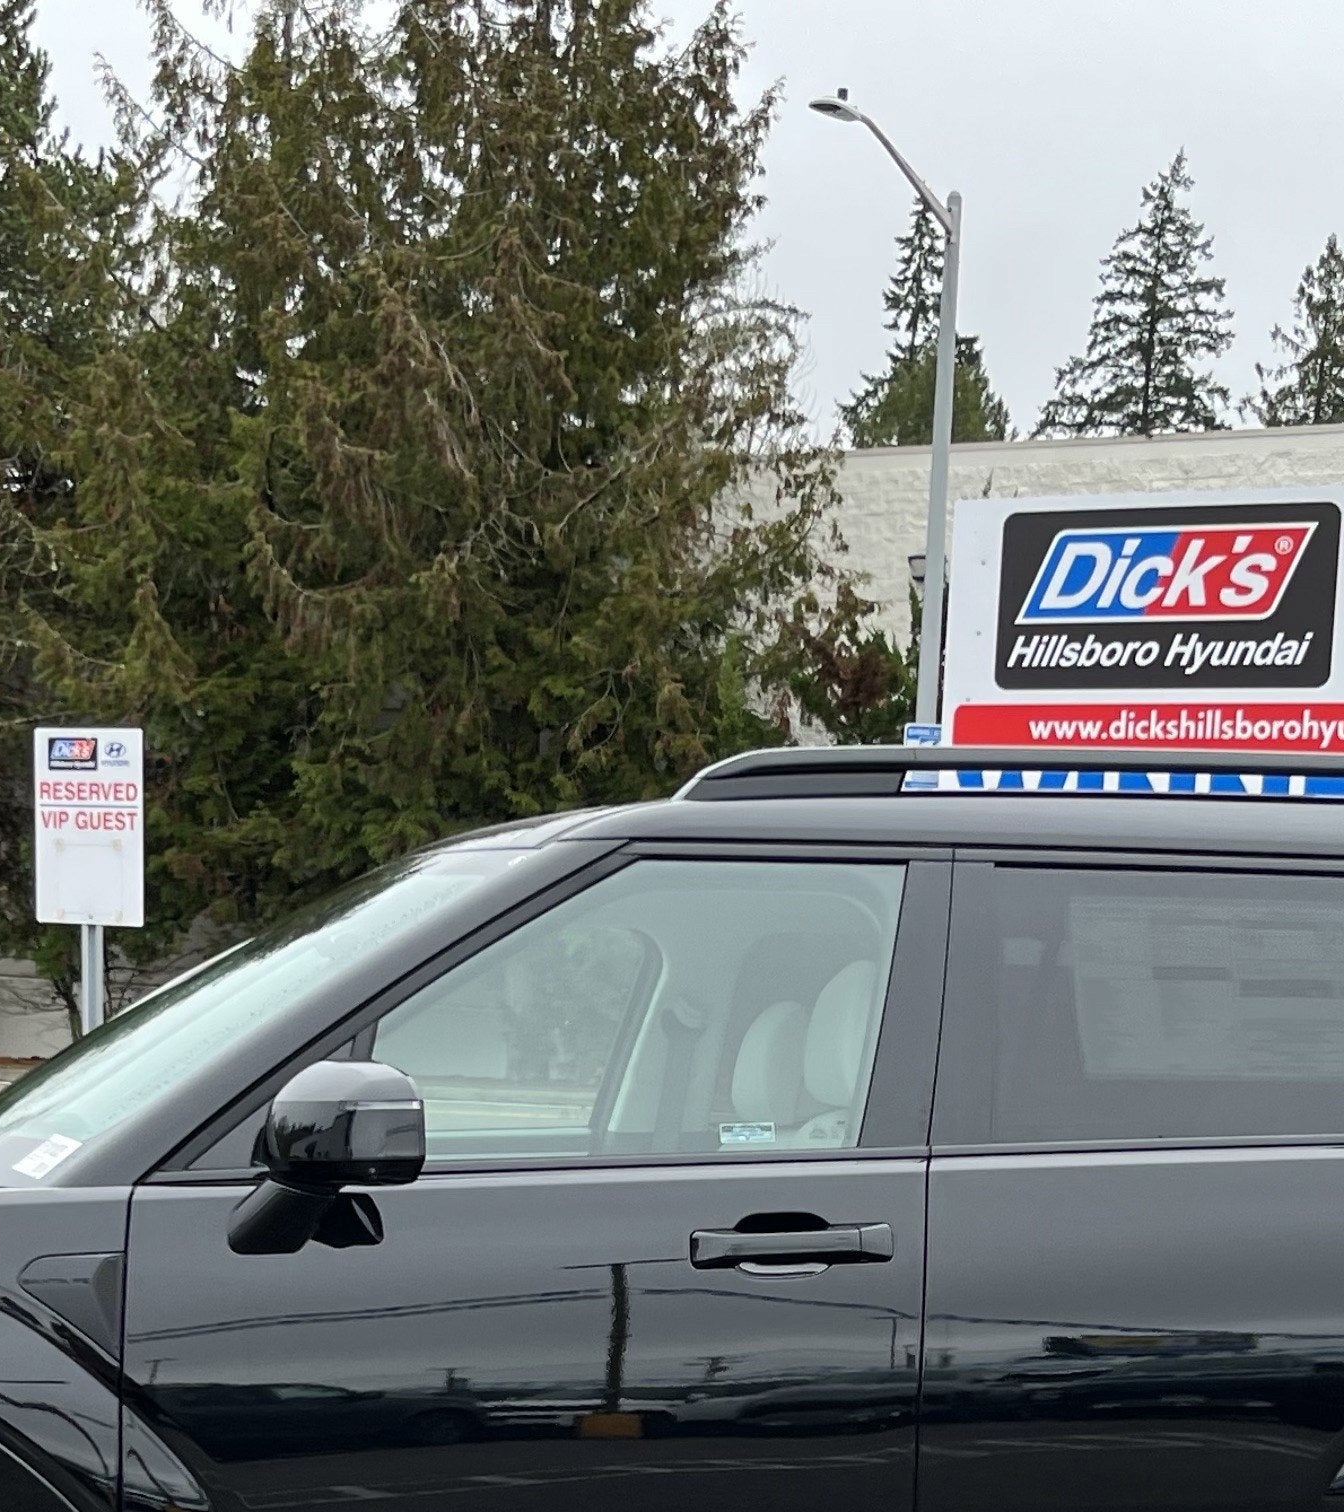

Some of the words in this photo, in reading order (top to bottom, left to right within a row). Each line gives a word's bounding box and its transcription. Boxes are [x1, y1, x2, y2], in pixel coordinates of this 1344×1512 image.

[1039, 535, 1278, 610] Dick's
[1007, 634, 1160, 669] Hillsboro
[1163, 631, 1315, 675] Hyundai
[39, 781, 139, 802] RESERVED
[40, 810, 70, 829] VIP
[75, 810, 139, 831] GUEST
